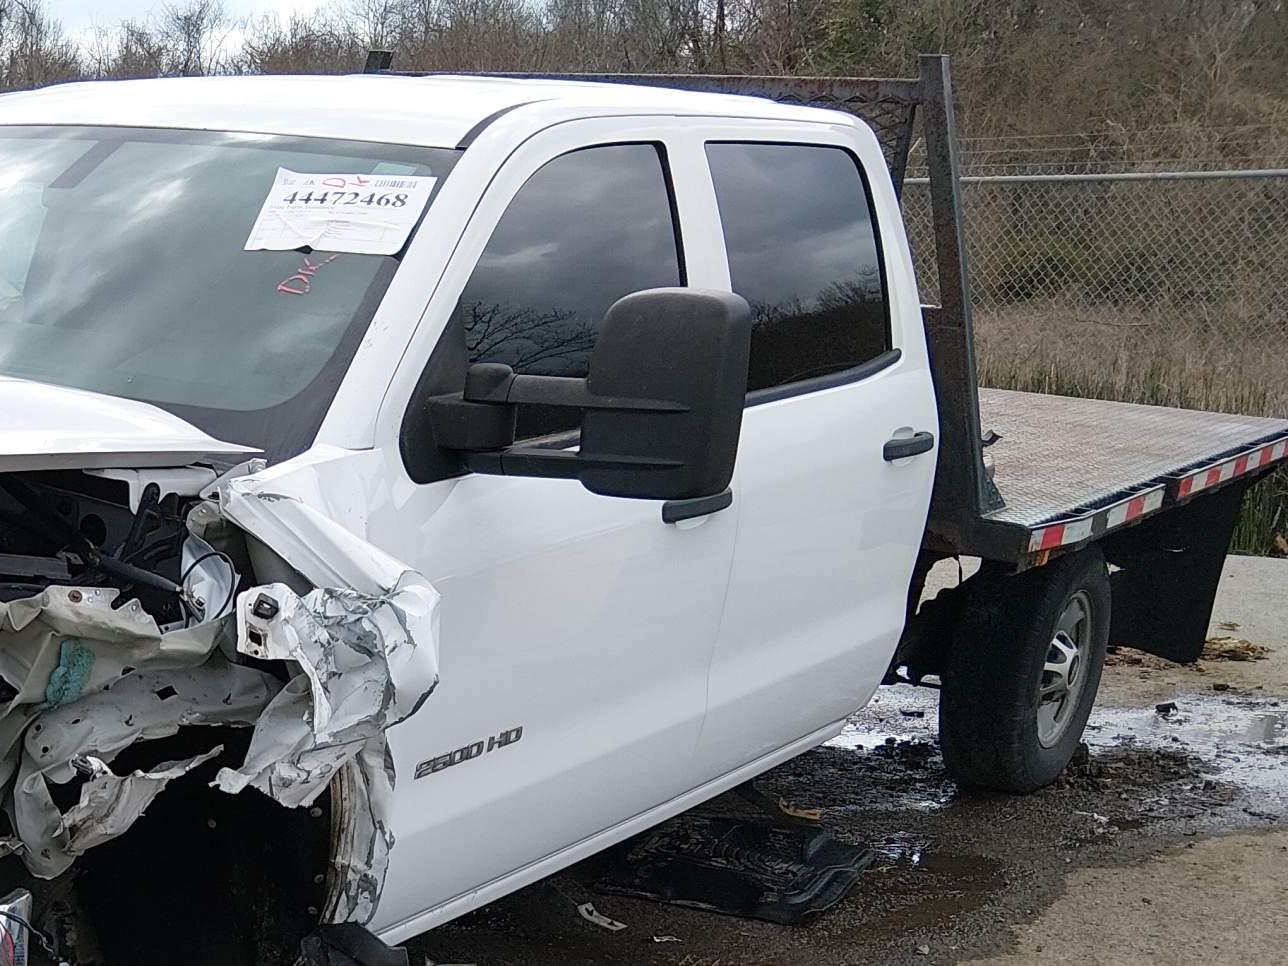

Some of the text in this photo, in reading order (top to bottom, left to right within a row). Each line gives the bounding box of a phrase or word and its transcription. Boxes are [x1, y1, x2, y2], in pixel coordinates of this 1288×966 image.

[283, 190, 409, 208] 44472468
[414, 725, 524, 780] 2500 HD
